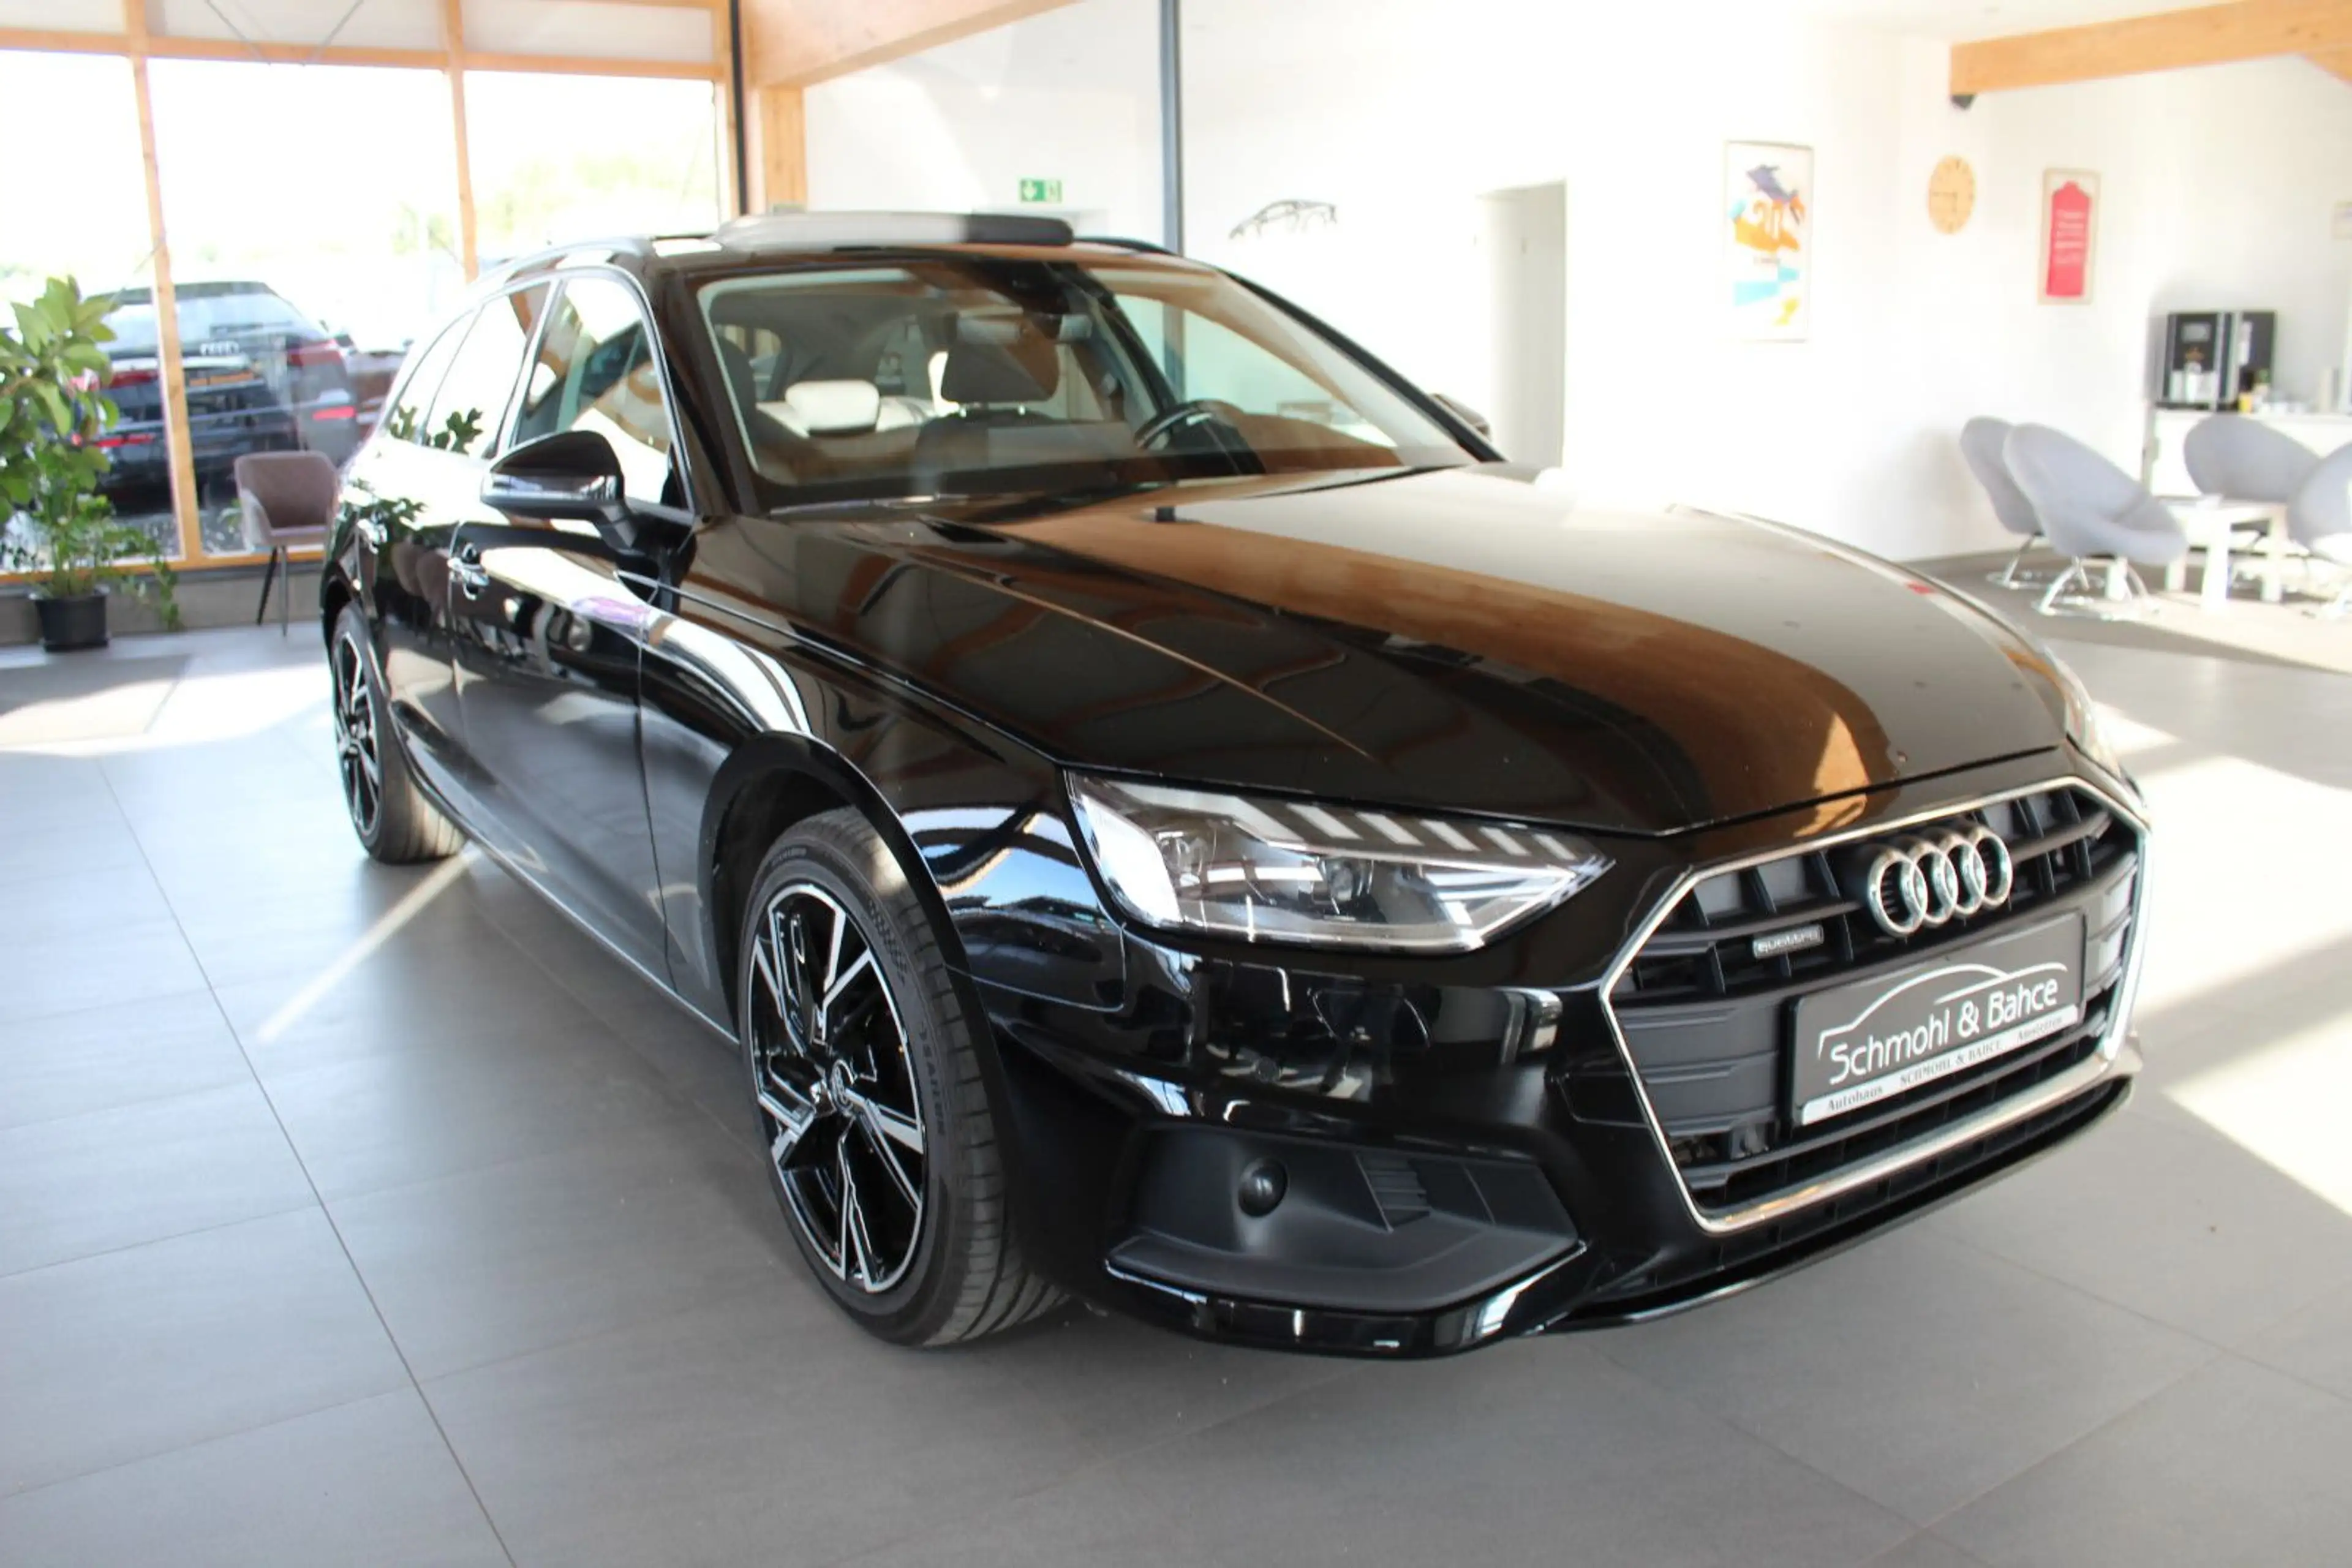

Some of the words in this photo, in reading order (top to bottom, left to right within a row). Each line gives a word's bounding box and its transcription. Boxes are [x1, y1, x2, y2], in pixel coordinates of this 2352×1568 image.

[1758, 929, 1819, 953] quattro
[1830, 1007, 1950, 1085] Schmohl
[1957, 1000, 1980, 1038] &
[1986, 978, 2059, 1030] Bahce
[1826, 1085, 1883, 1112] Autohaus
